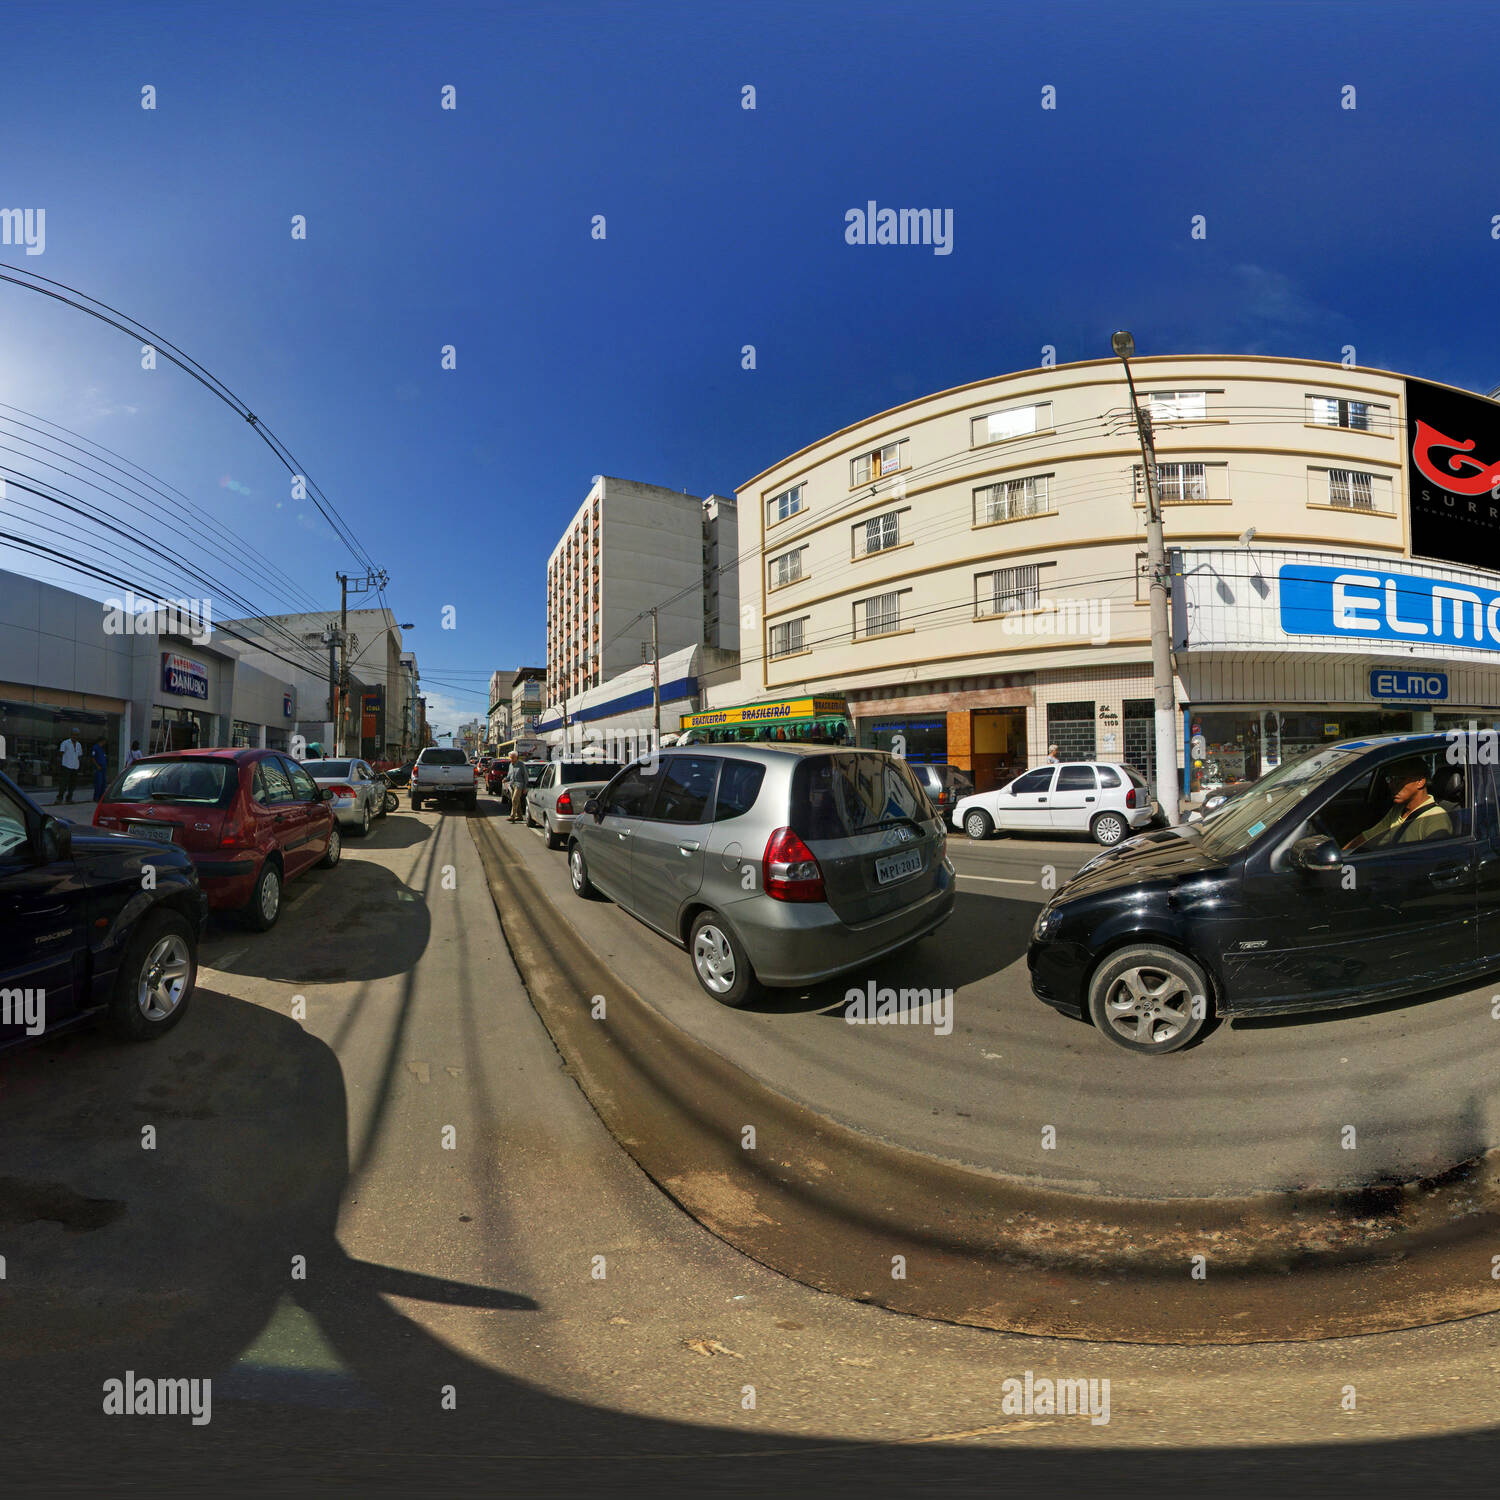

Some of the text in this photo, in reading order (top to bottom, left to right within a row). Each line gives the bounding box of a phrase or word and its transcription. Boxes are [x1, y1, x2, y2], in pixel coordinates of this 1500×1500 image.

[1377, 674, 1442, 695] ELMO
[692, 703, 791, 726] BRASILEIRÃO BRASILEIRÃO
